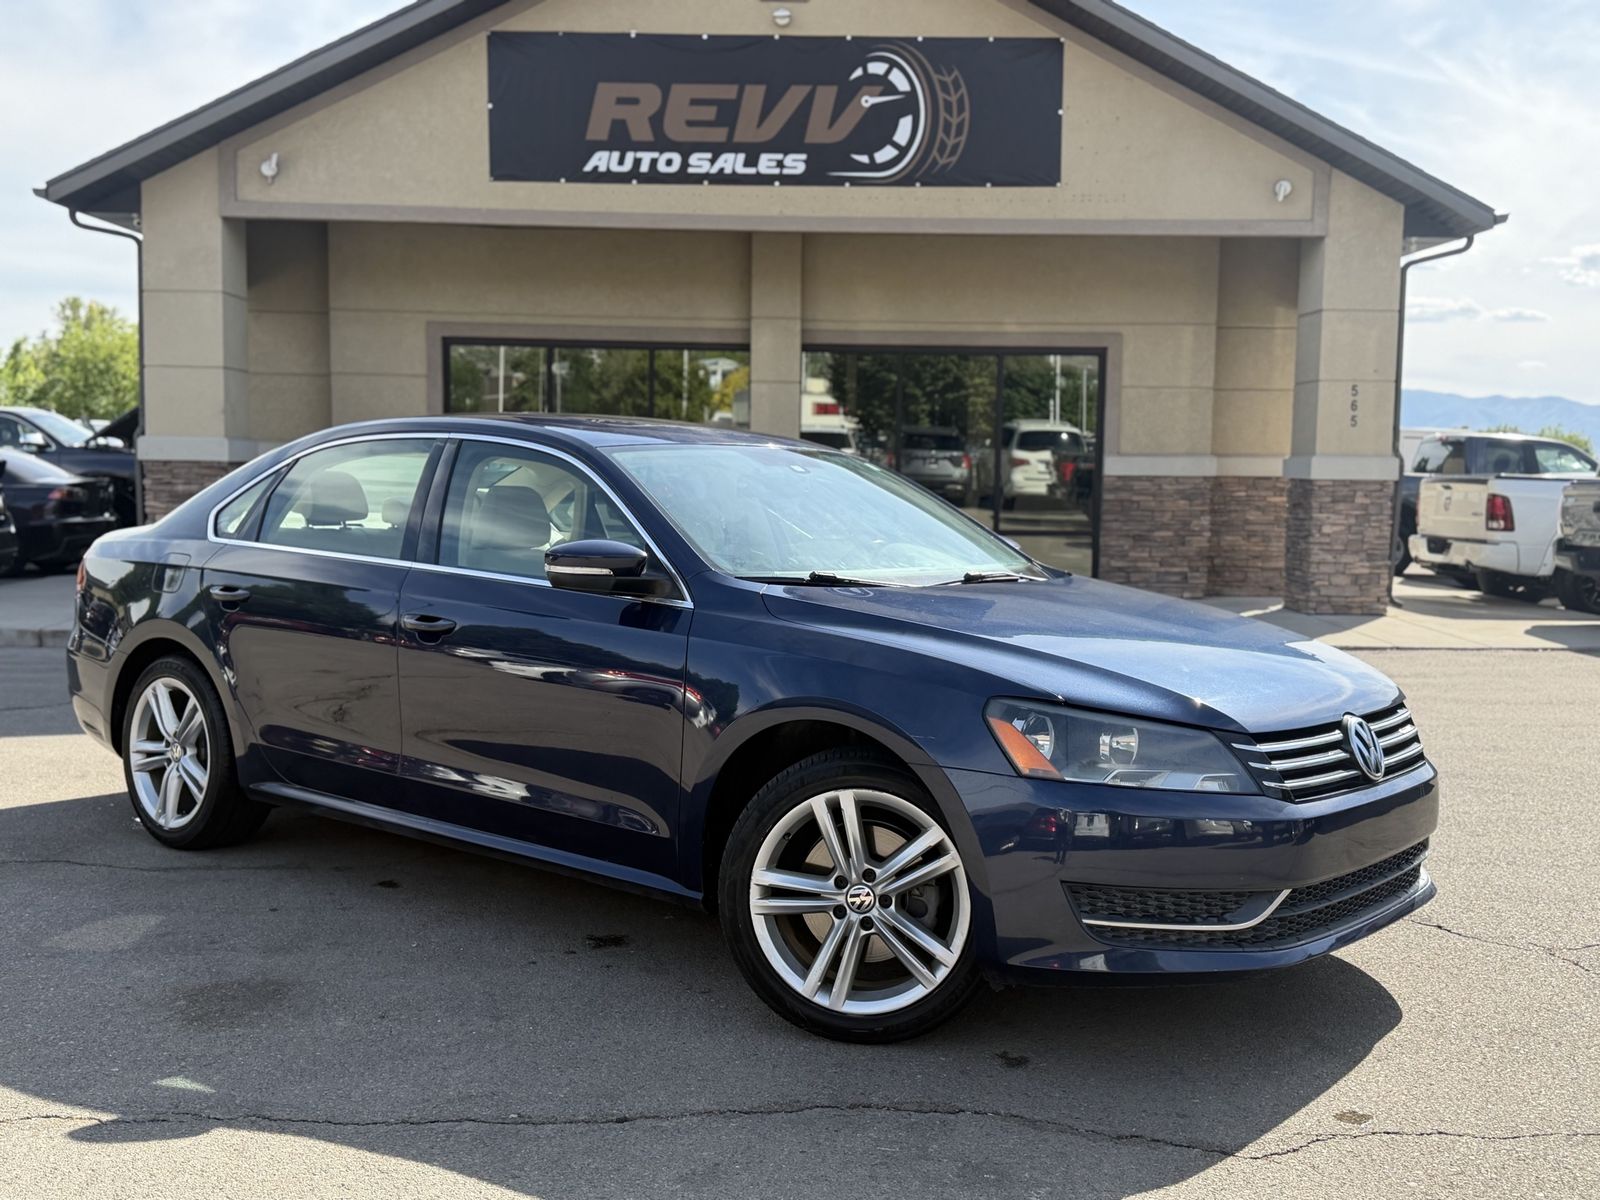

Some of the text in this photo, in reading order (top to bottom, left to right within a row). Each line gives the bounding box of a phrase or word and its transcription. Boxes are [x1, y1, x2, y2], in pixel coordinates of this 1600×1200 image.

[585, 82, 884, 143] REVV
[583, 150, 807, 175] AUTO SALES
[1350, 384, 1359, 428] 565
